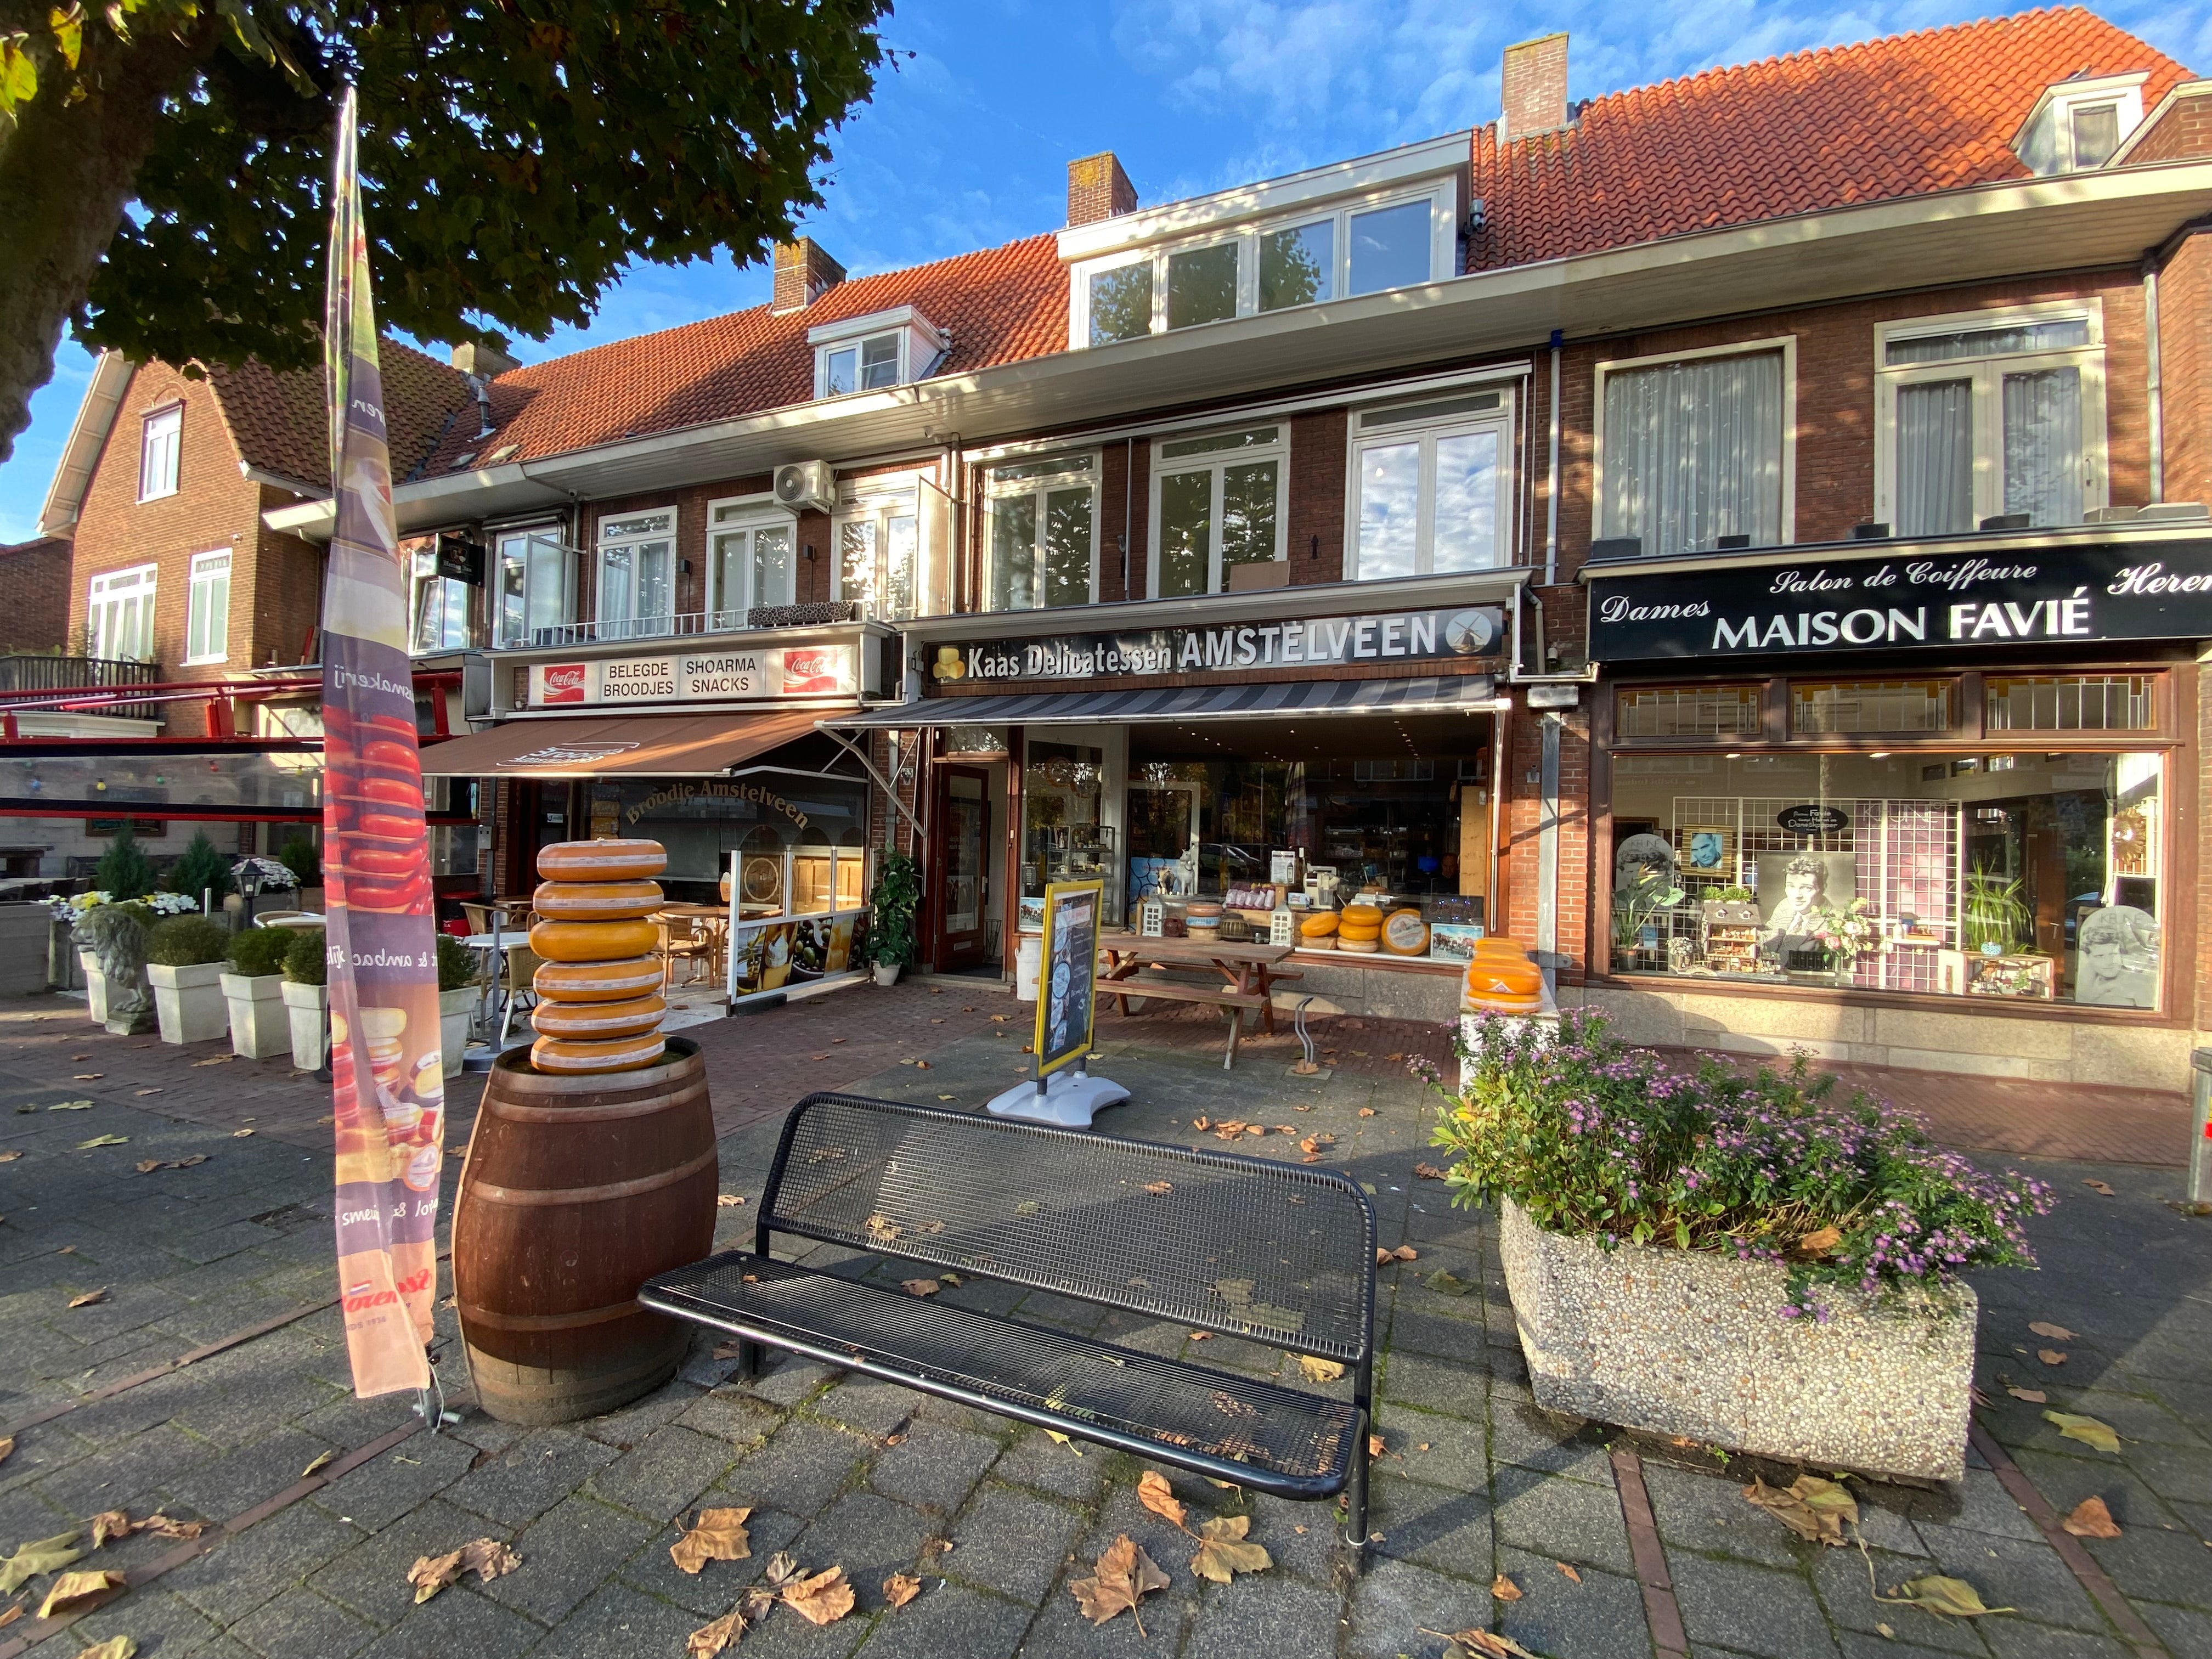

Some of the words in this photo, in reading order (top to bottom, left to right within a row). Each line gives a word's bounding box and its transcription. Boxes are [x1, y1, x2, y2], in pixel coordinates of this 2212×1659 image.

[1769, 569, 1853, 594] Salon
[1863, 565, 1897, 588] de
[1905, 558, 2038, 590] Coiffeure
[1600, 595, 1711, 623] Dames
[1712, 607, 1925, 650] MAISON
[1950, 586, 2089, 639] FAVIÉ
[968, 647, 1021, 679] Kaas
[1027, 642, 1172, 676] Delicatessen
[1180, 615, 1436, 668] AMSTELVEEN
[610, 663, 668, 678] BELEGDE
[686, 657, 756, 674] SHOARMA
[604, 681, 673, 697] BROODJES
[692, 677, 748, 693] SNACKS
[625, 782, 695, 825] Broodje
[700, 780, 809, 830] Amstelveen
